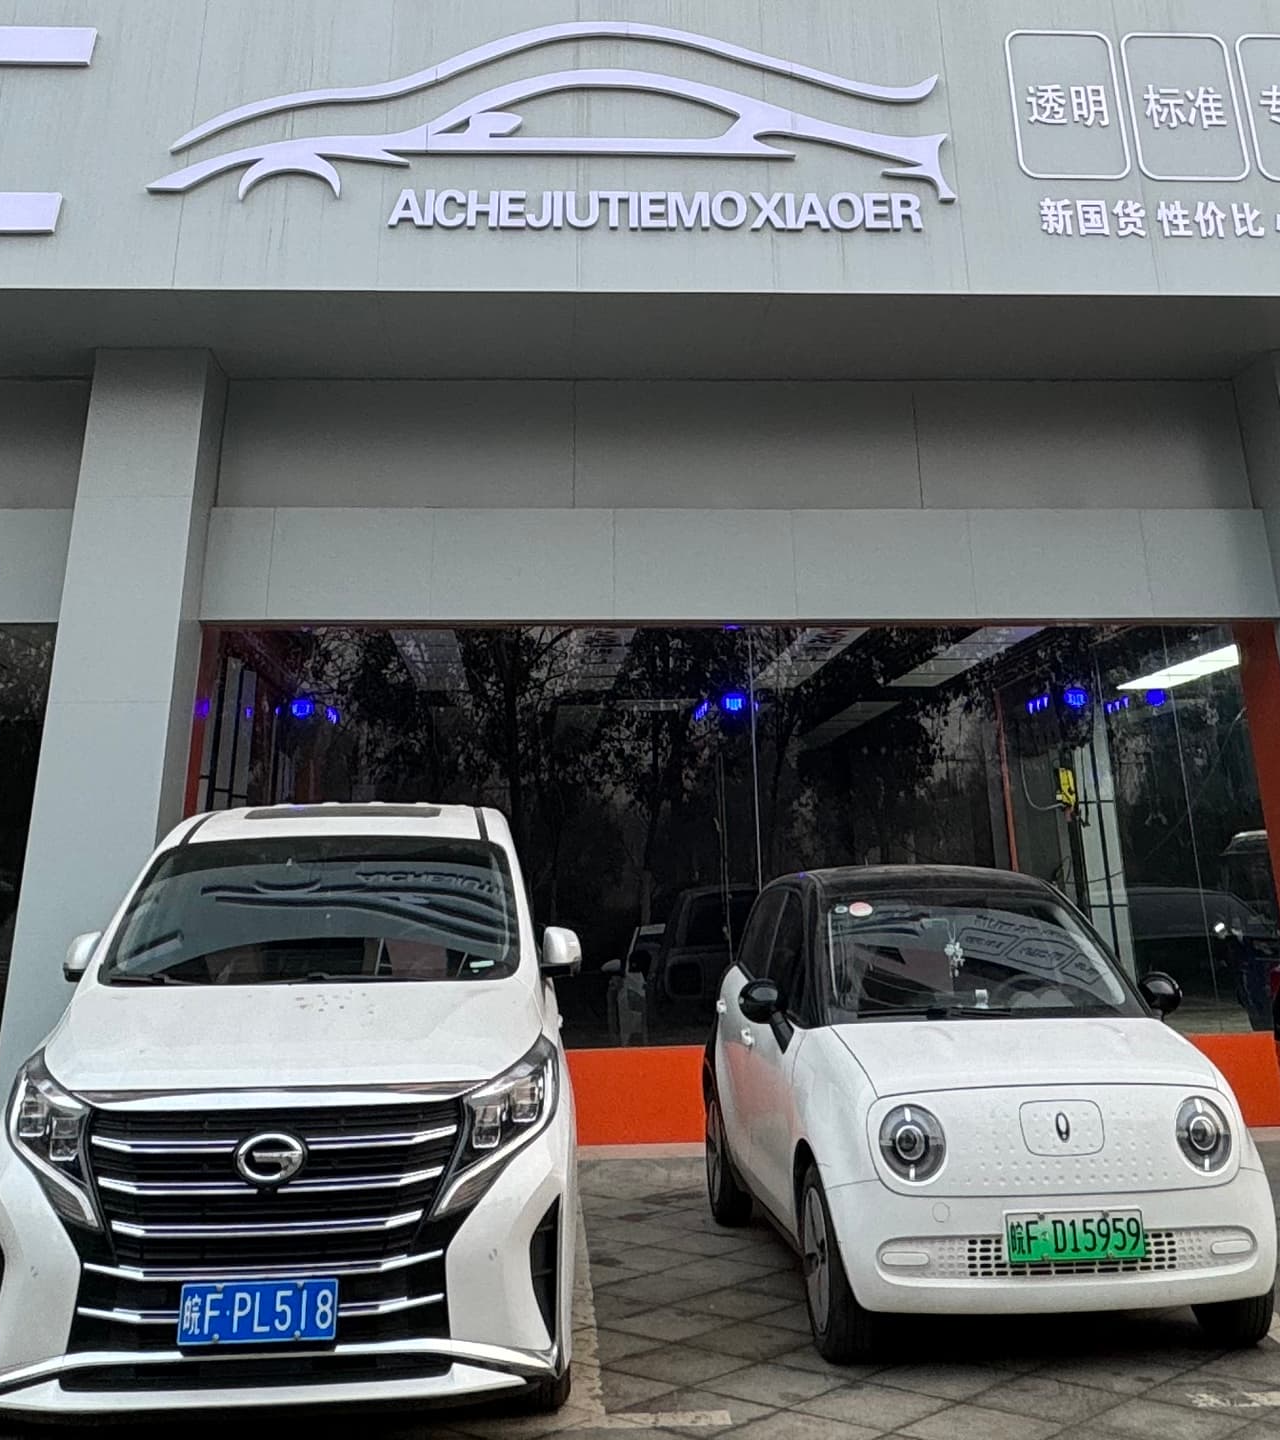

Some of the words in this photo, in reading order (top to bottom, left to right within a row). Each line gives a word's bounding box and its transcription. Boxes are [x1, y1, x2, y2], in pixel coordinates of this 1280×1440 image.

[1025, 84, 1111, 127] 透明
[1143, 84, 1227, 129] 标准
[1039, 197, 1147, 237] 新国货
[1156, 200, 1265, 238] 性价比
